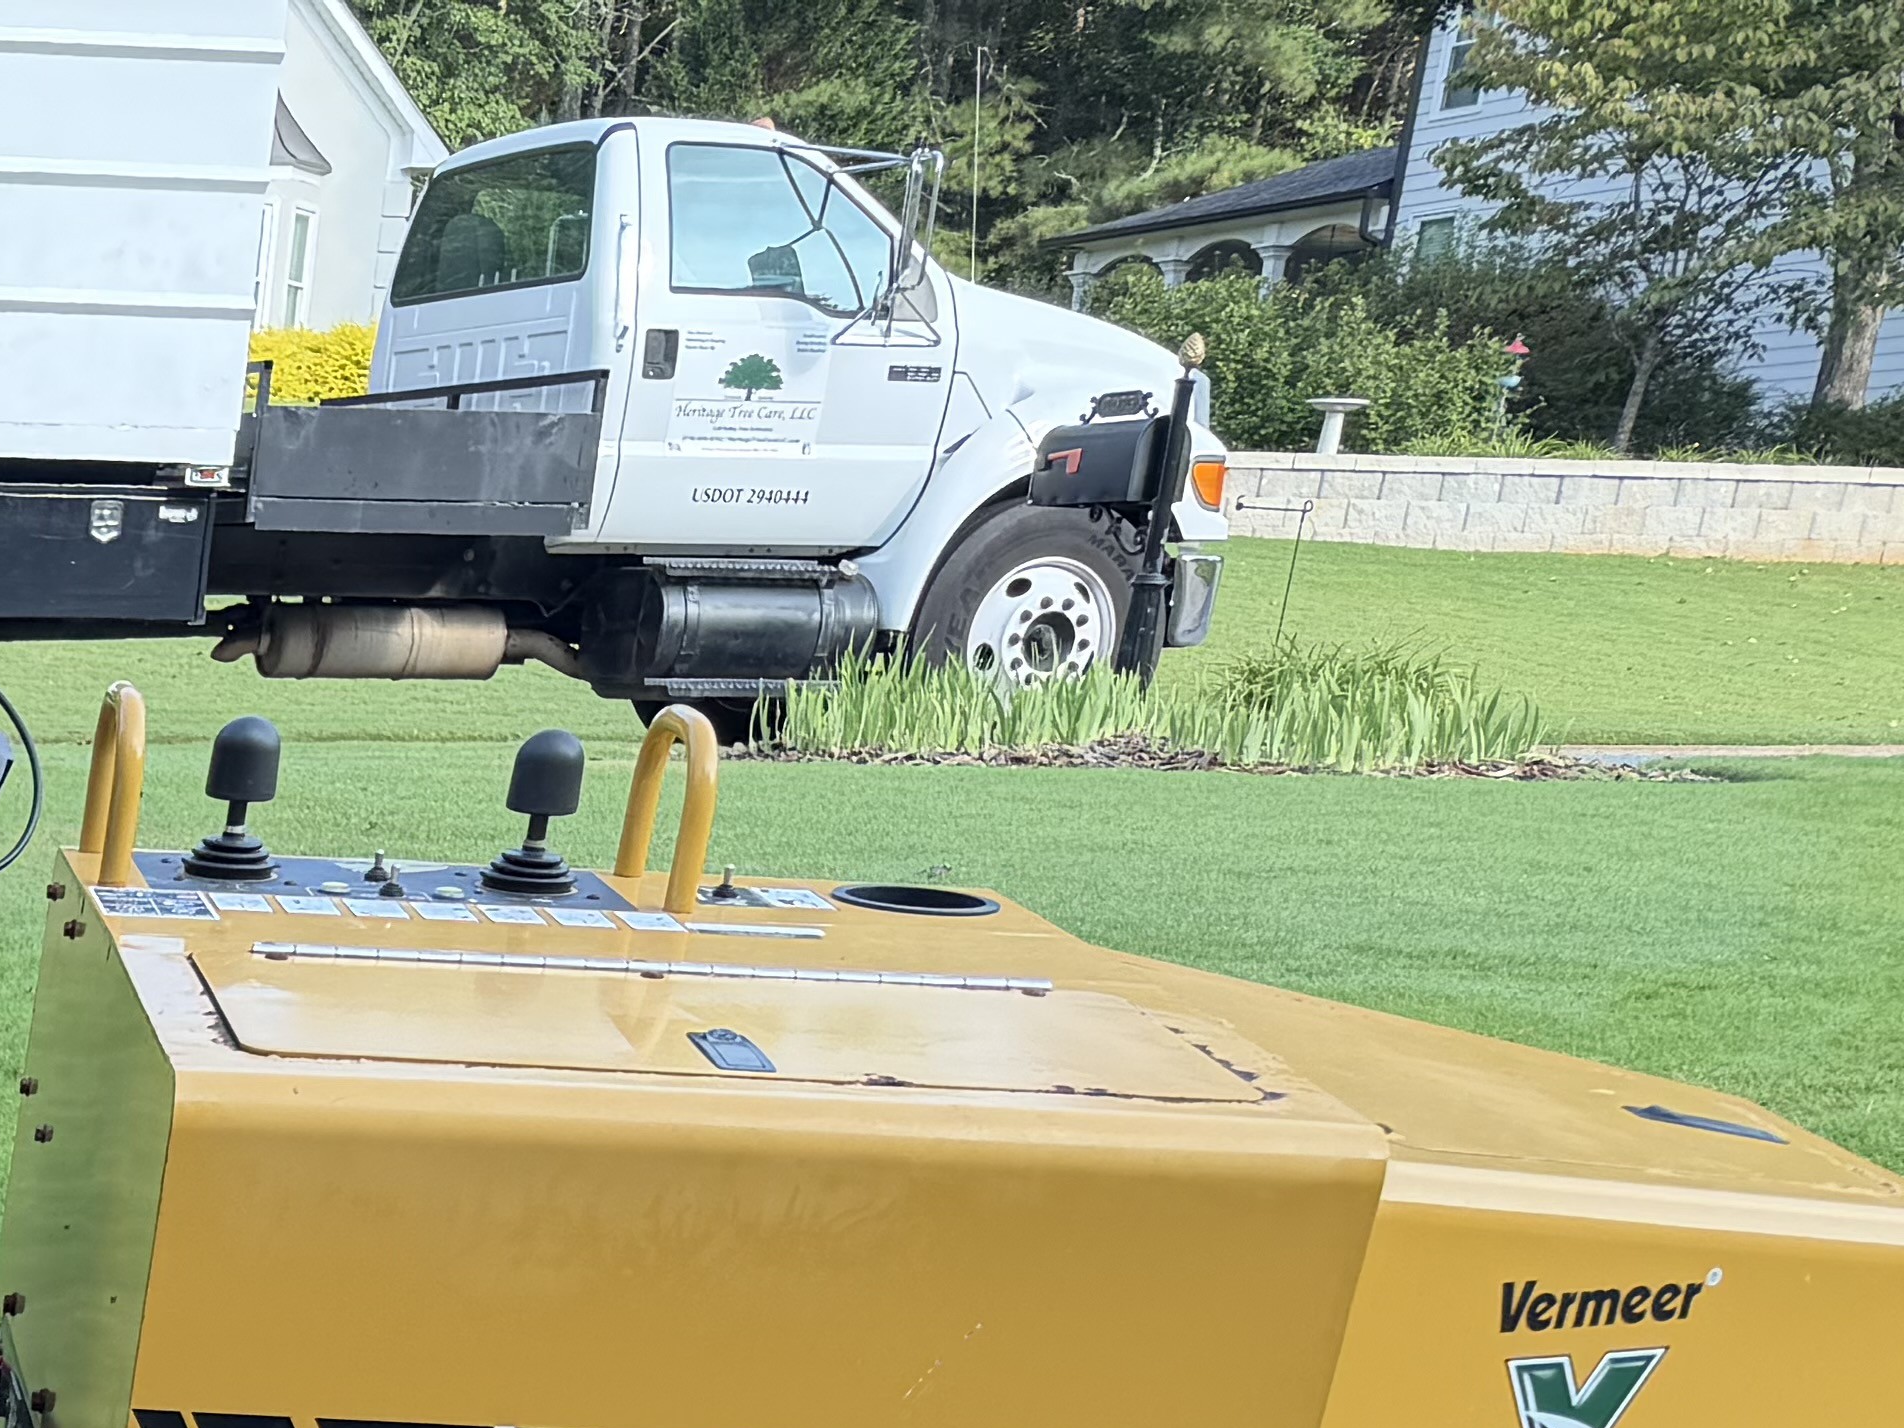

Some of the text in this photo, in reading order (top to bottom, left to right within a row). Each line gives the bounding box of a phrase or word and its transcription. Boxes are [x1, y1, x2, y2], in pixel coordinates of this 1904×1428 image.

[728, 403, 754, 420] Tree
[789, 406, 818, 421] LLC
[692, 487, 810, 504] USDOT 2940444
[1500, 1280, 1704, 1333] Vermeer
